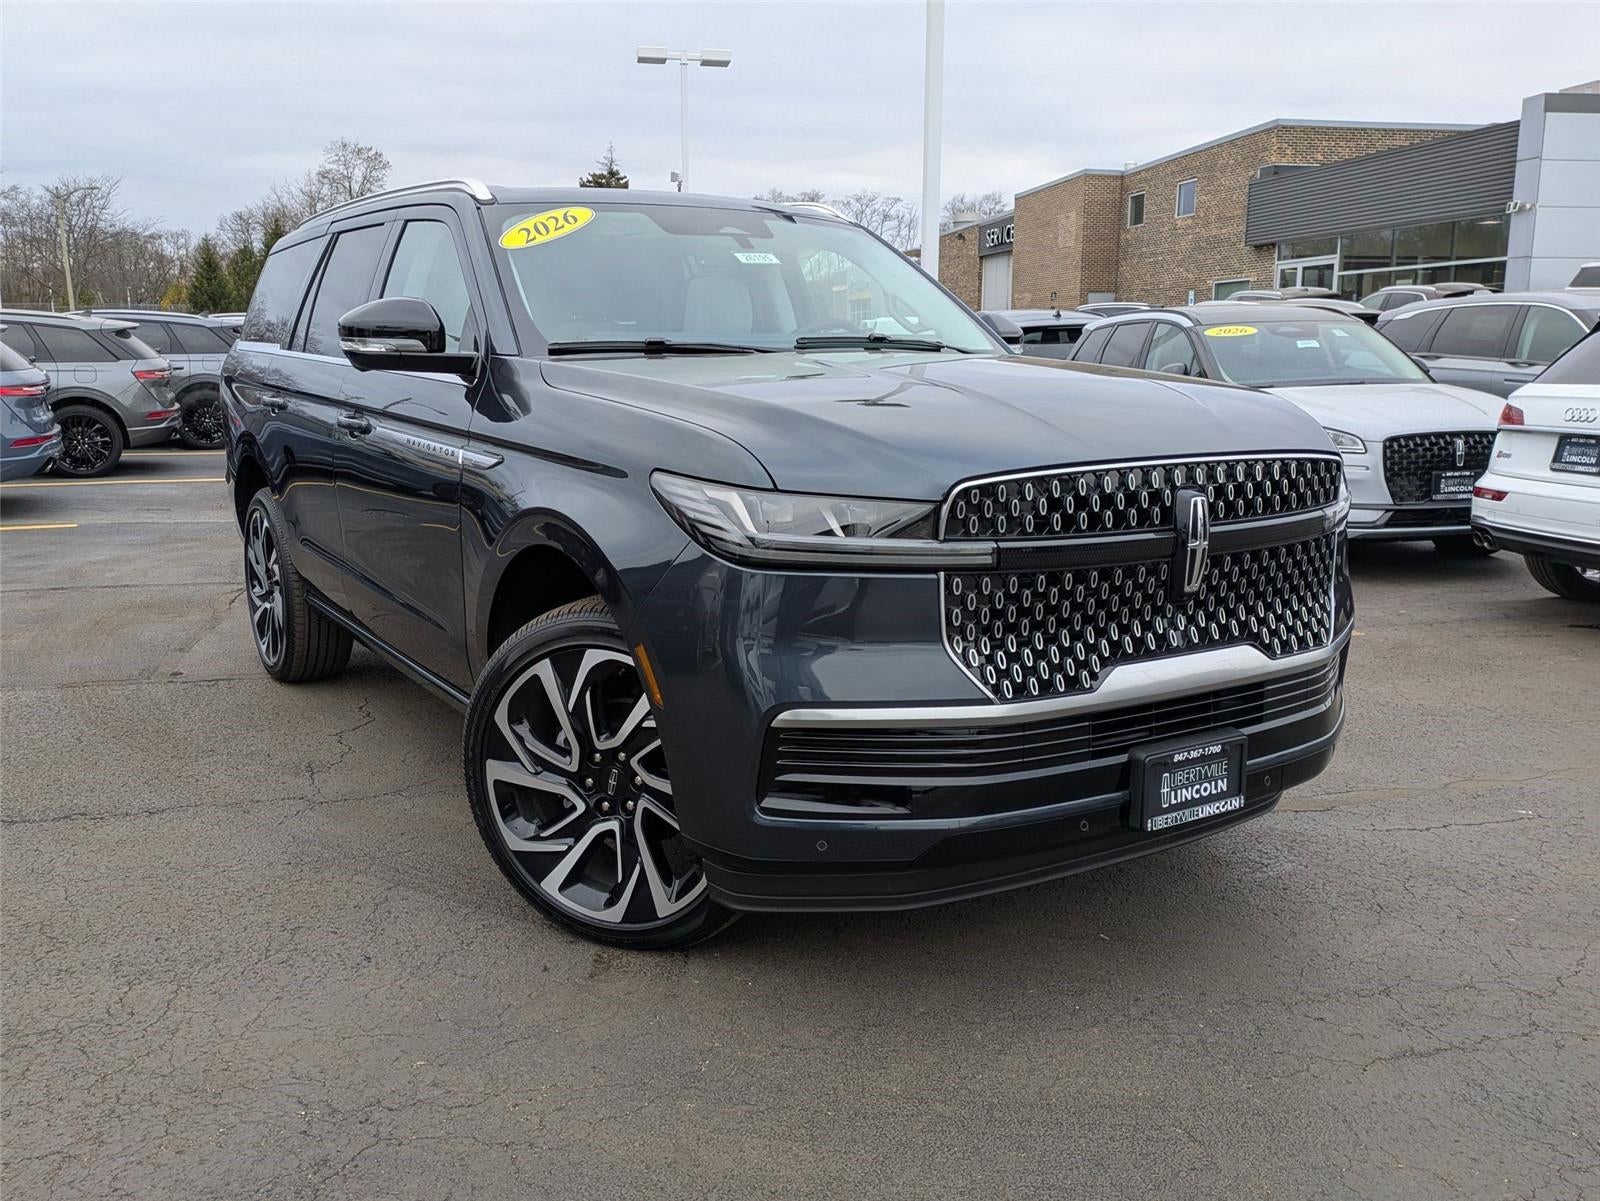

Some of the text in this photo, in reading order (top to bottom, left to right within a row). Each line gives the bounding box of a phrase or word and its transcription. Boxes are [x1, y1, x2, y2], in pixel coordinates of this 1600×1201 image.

[517, 210, 579, 244] 2026
[985, 224, 1015, 247] SERVICE
[1215, 327, 1248, 336] 2026
[405, 438, 456, 457] NAVIGATOR
[1566, 455, 1597, 464] LINCOLN
[1444, 485, 1473, 493] LINCOLN
[1173, 744, 1222, 763] 847-367-1700
[1170, 760, 1228, 787] LIBERTYVILLE
[1170, 778, 1228, 805] LINCOLN
